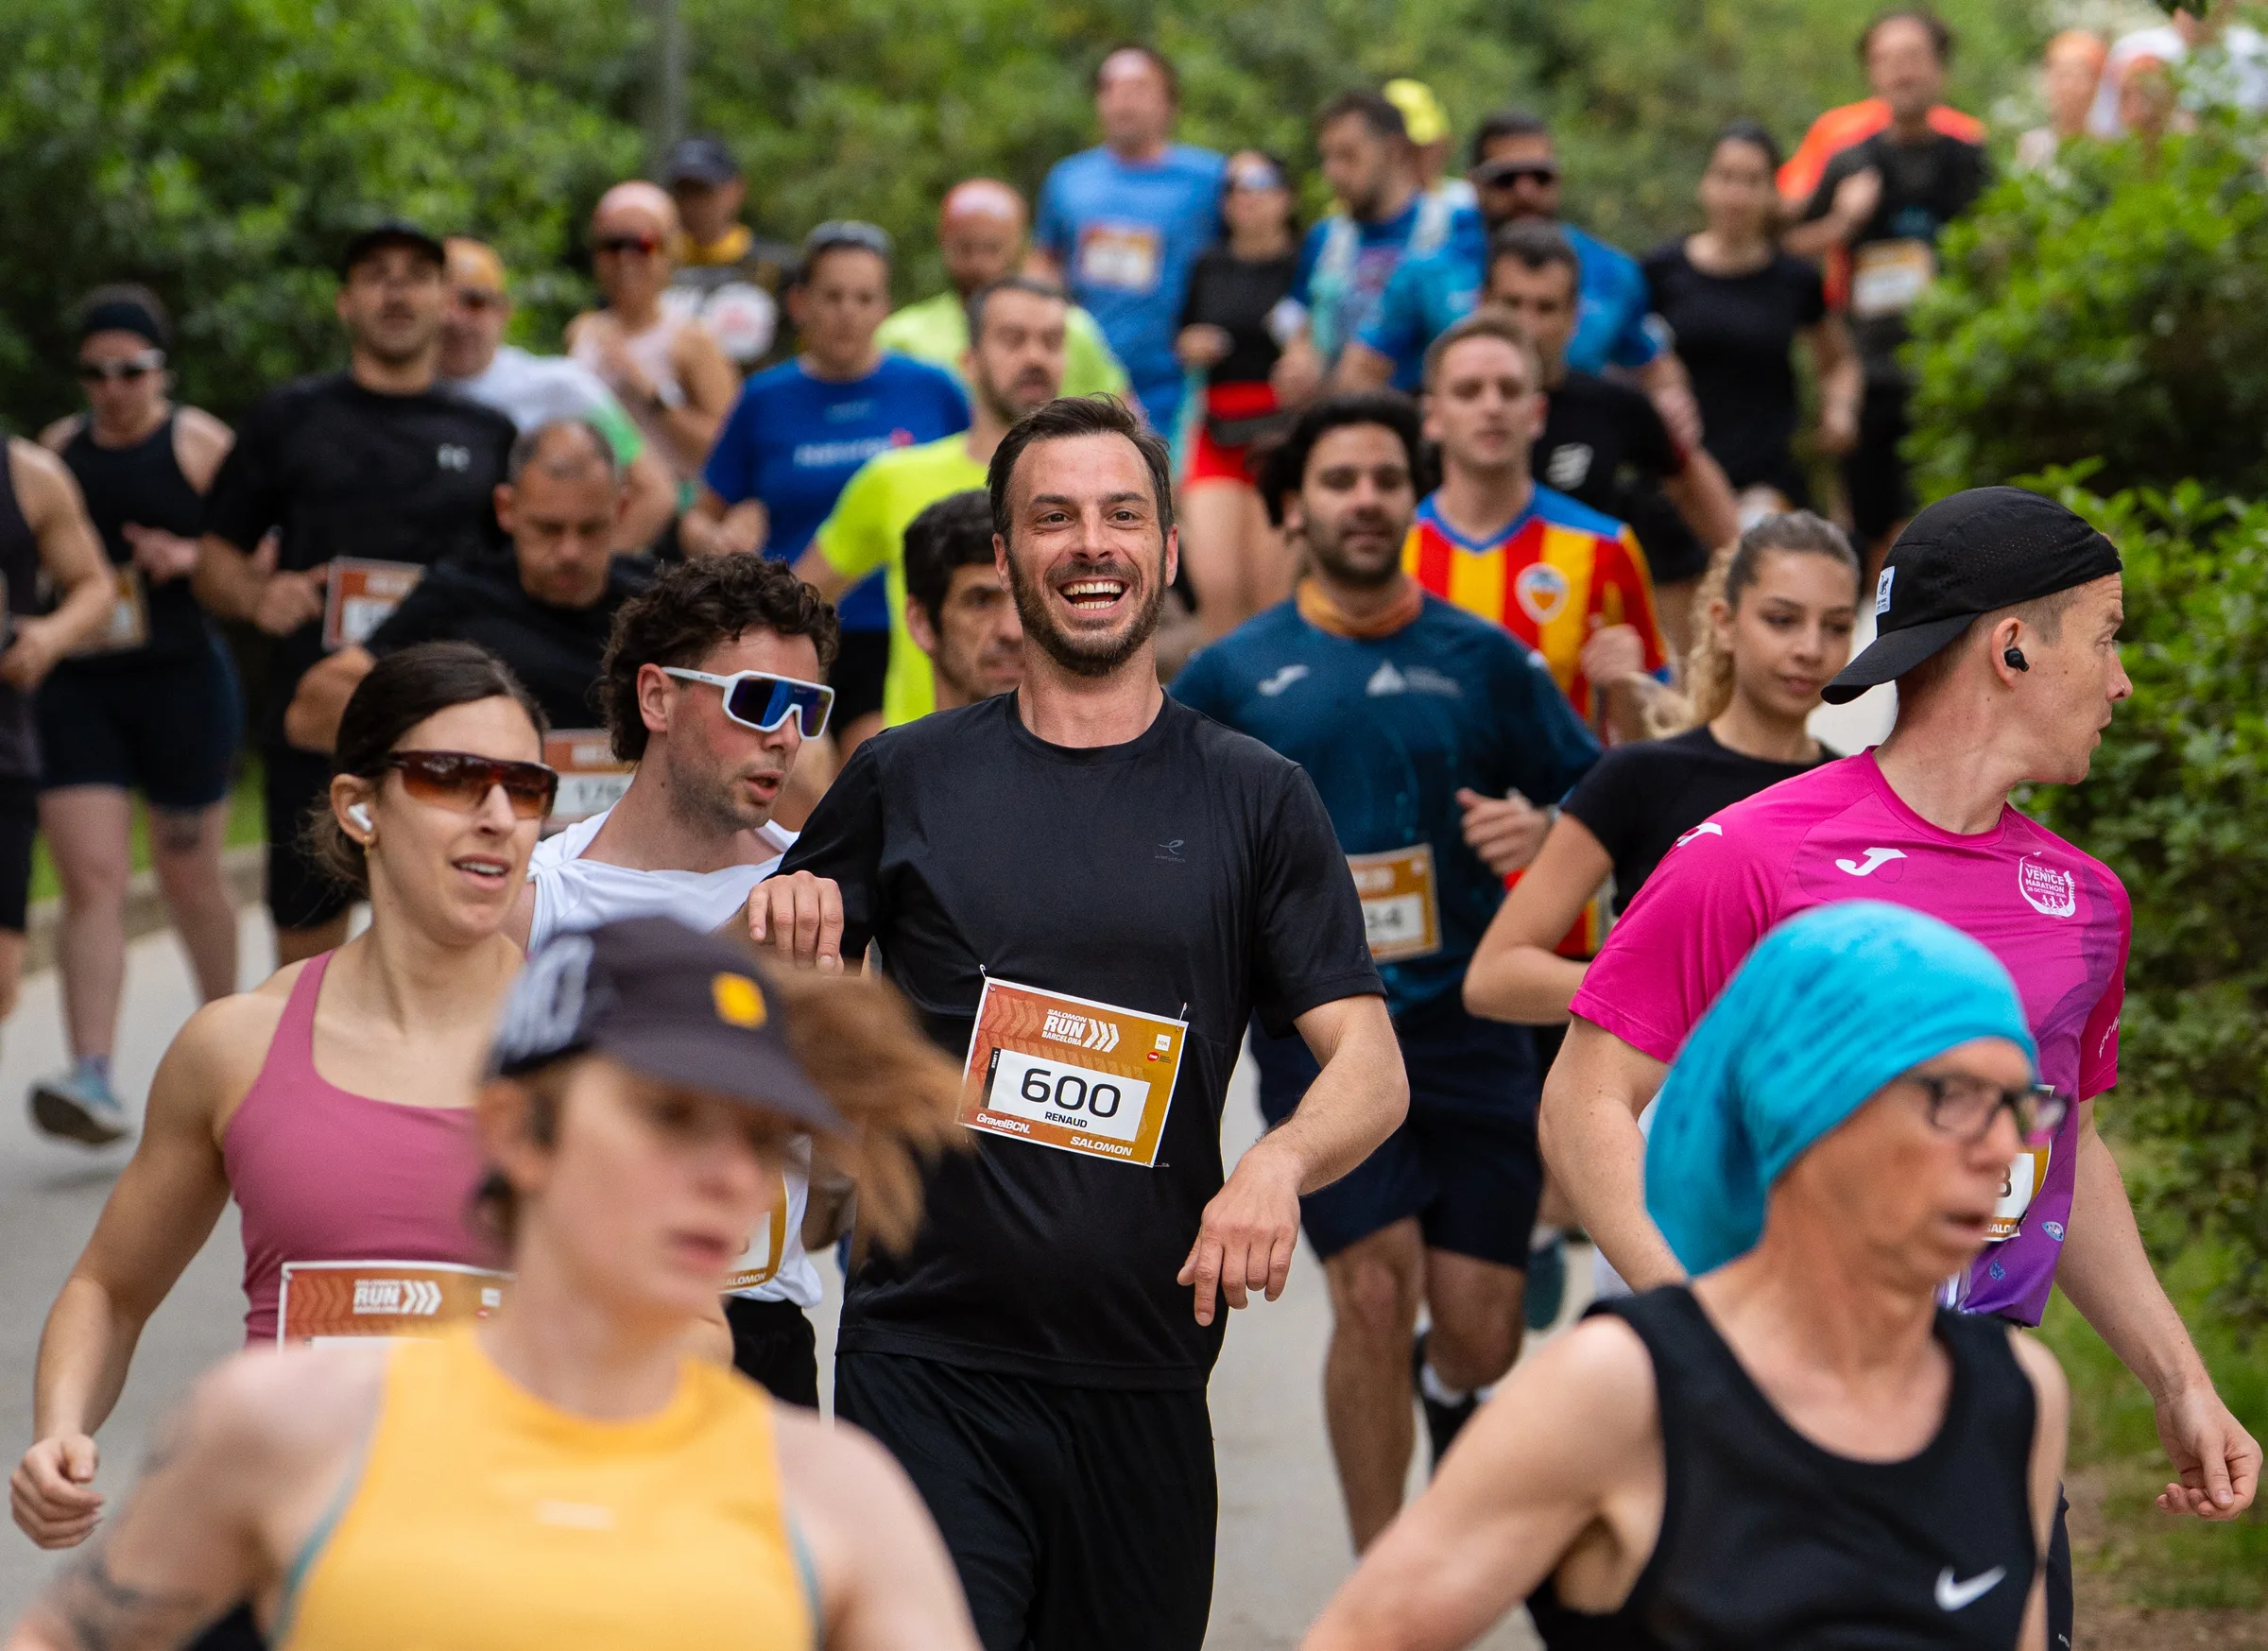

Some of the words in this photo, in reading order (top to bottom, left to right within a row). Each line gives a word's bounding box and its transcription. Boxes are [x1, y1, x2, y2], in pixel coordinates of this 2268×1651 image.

[2025, 868, 2065, 886] VENICE
[2025, 879, 2065, 893] MARATHON
[1047, 1008, 1088, 1023] SALOMON
[1043, 1015, 1086, 1039] RUN
[1041, 1030, 1082, 1046] BARCELONA
[1021, 1068, 1122, 1118] 600
[976, 1112, 1031, 1134] GravelBCN.
[1044, 1111, 1088, 1128] RENAUD
[1070, 1136, 1133, 1157] SALOMON
[725, 1272, 766, 1286] ALOMON
[354, 1286, 402, 1304] RUN
